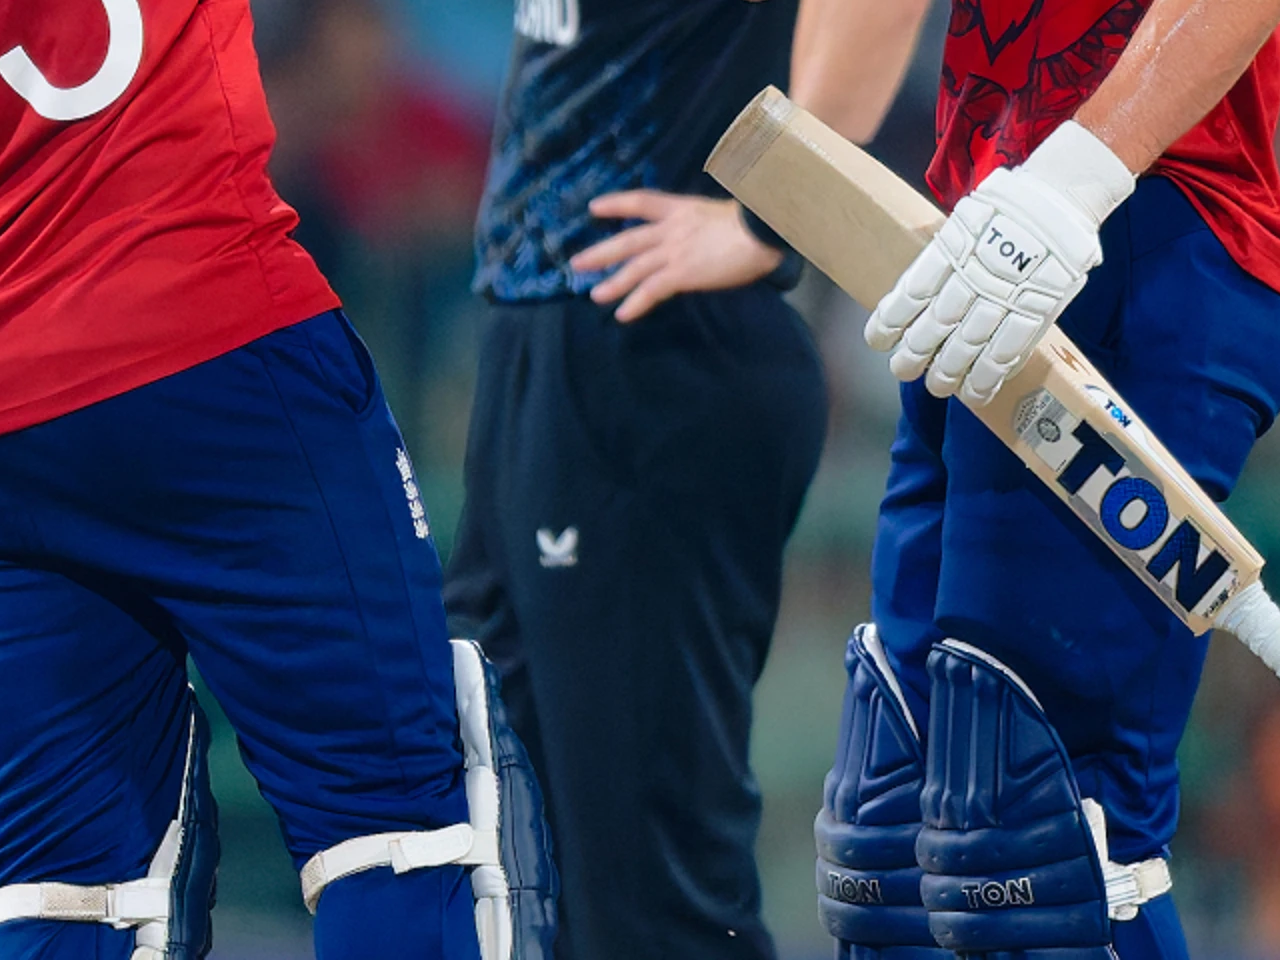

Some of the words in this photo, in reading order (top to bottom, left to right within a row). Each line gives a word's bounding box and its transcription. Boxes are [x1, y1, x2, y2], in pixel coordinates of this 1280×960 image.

[987, 227, 1032, 273] TON
[1104, 398, 1133, 429] TON
[1056, 419, 1231, 614] TON
[827, 871, 884, 904] TON
[962, 877, 1034, 908] TON
